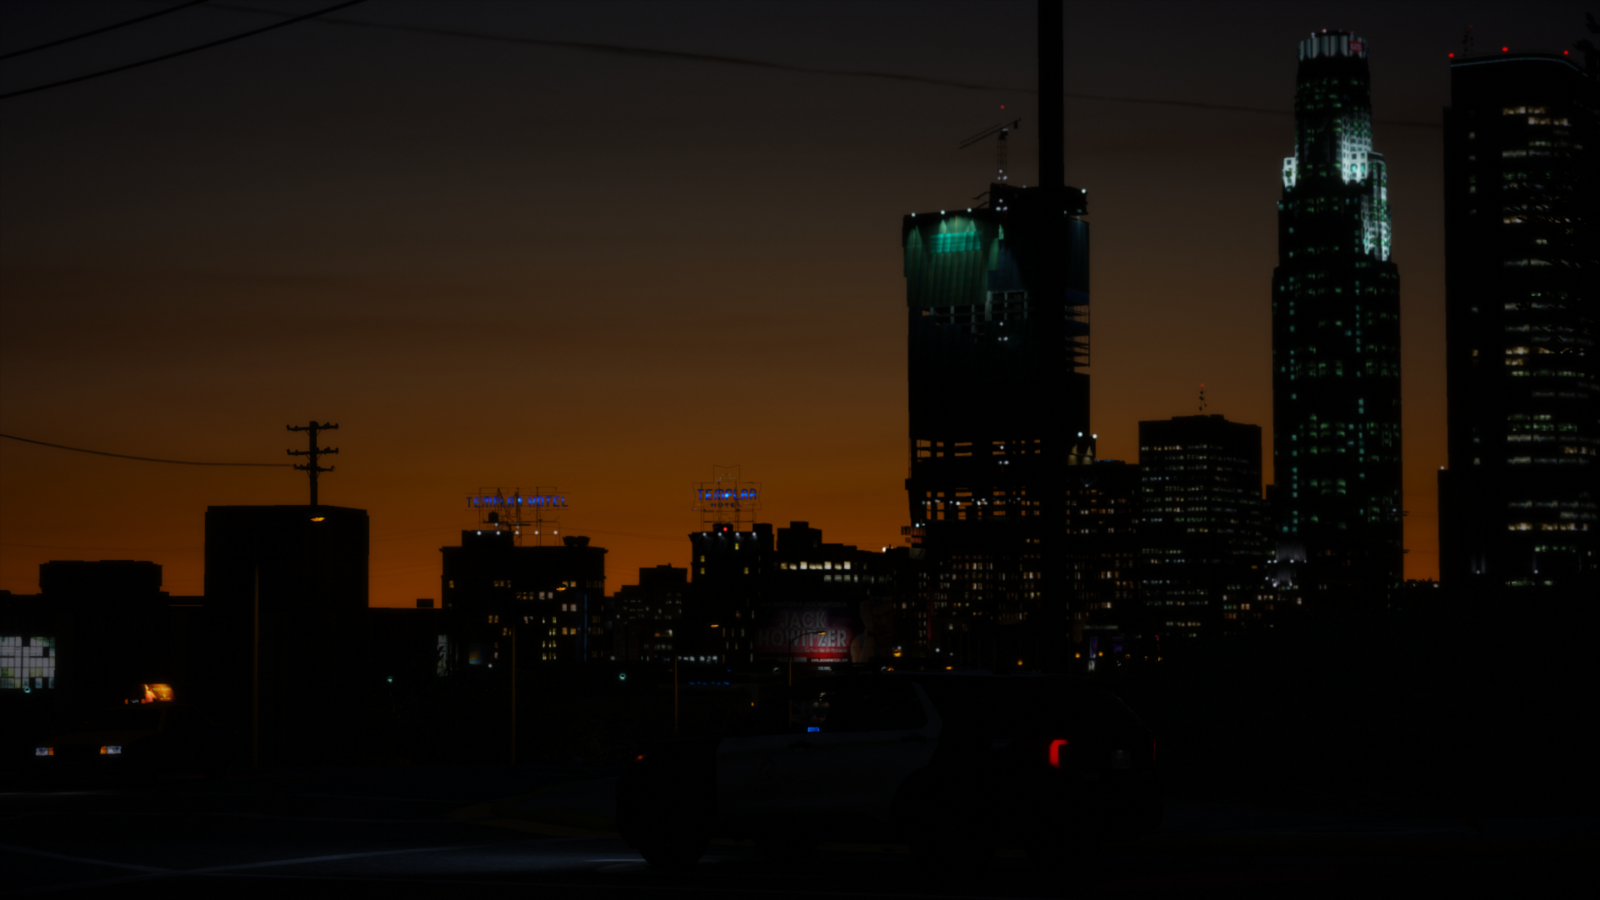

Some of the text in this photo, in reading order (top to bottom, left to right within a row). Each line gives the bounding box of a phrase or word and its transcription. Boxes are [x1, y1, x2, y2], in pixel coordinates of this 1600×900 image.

[466, 496, 568, 508] TEMPLAR HOTEL
[697, 488, 757, 501] TEMPLAR
[780, 610, 826, 629] JACK
[758, 629, 847, 648] HOWITZER
